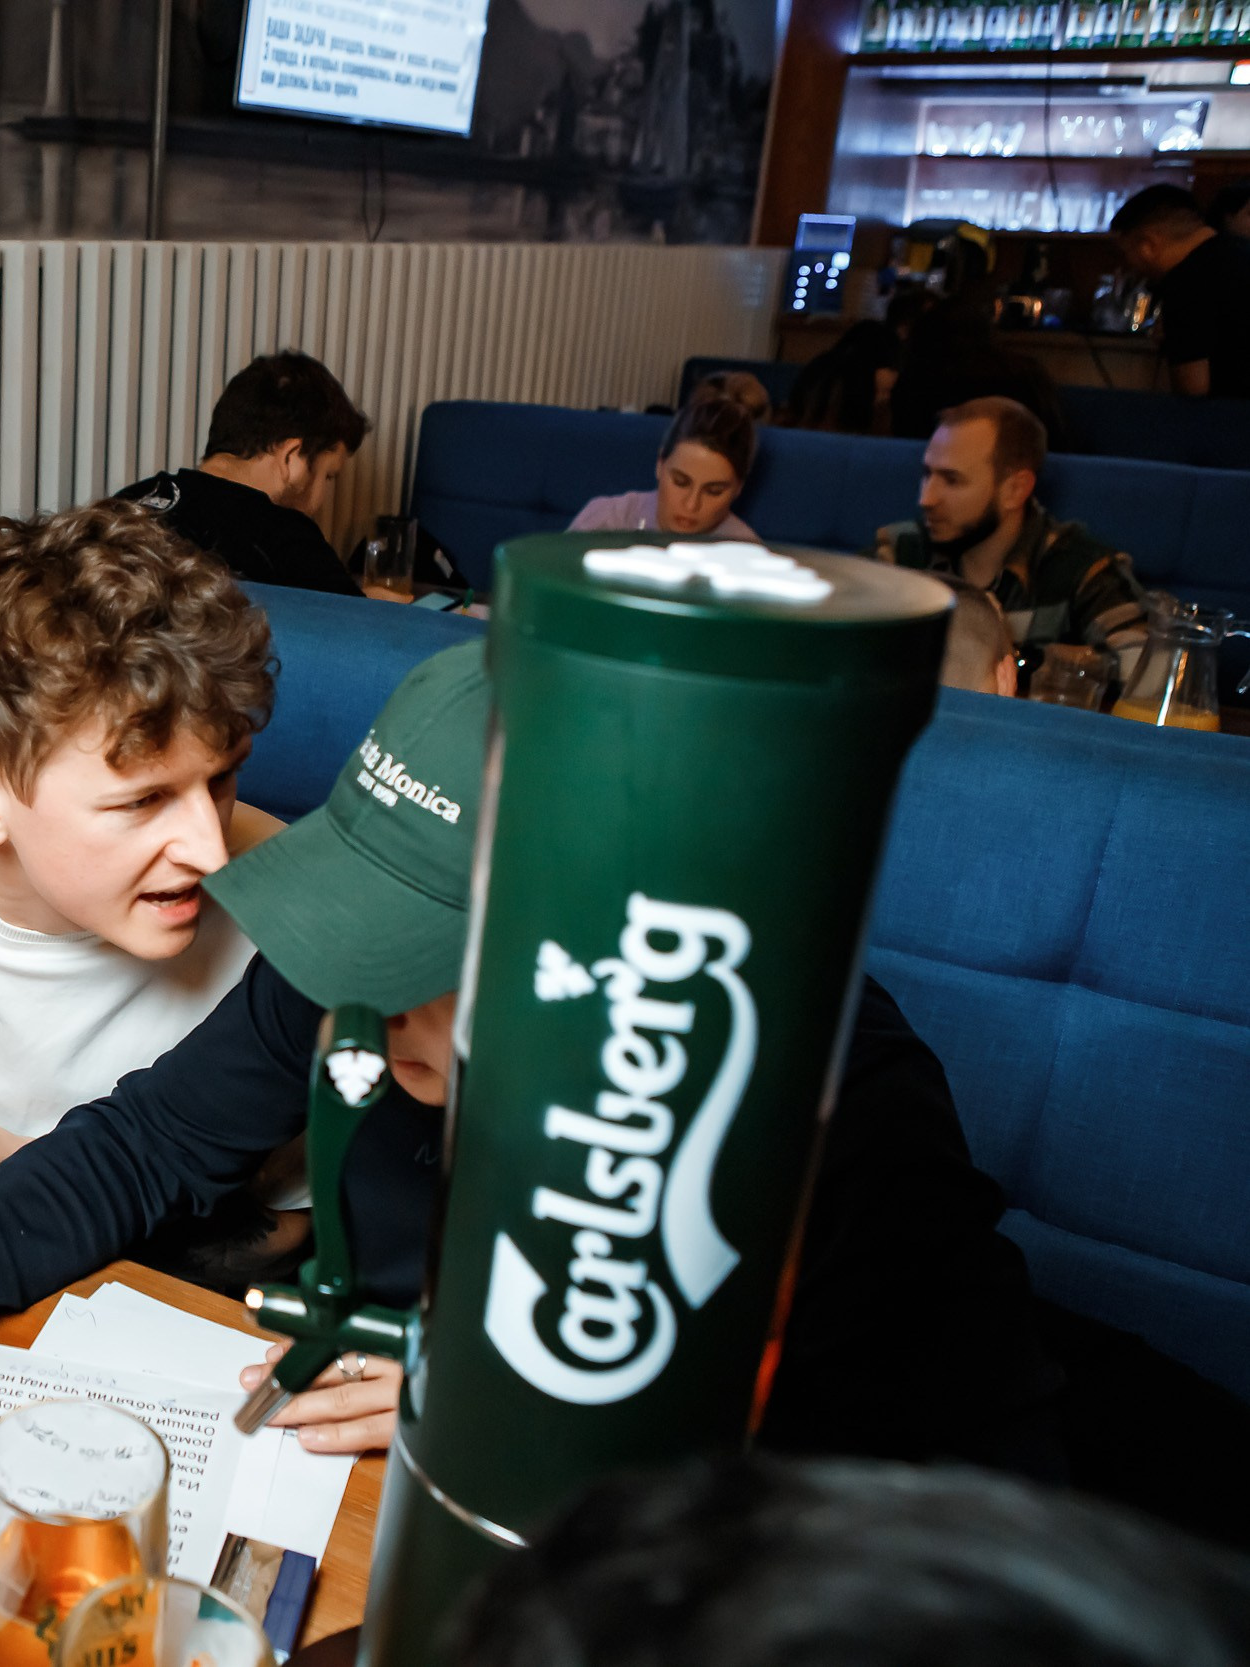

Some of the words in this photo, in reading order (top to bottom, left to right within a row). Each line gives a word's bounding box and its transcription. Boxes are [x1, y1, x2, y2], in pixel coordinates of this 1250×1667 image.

[372, 752, 461, 824] Monica
[484, 891, 759, 1405] Carlsberg
[19, 1376, 49, 1389] над
[52, 1384, 79, 1396] что
[160, 1405, 220, 1422] размах
[156, 1418, 216, 1437] Отыщи
